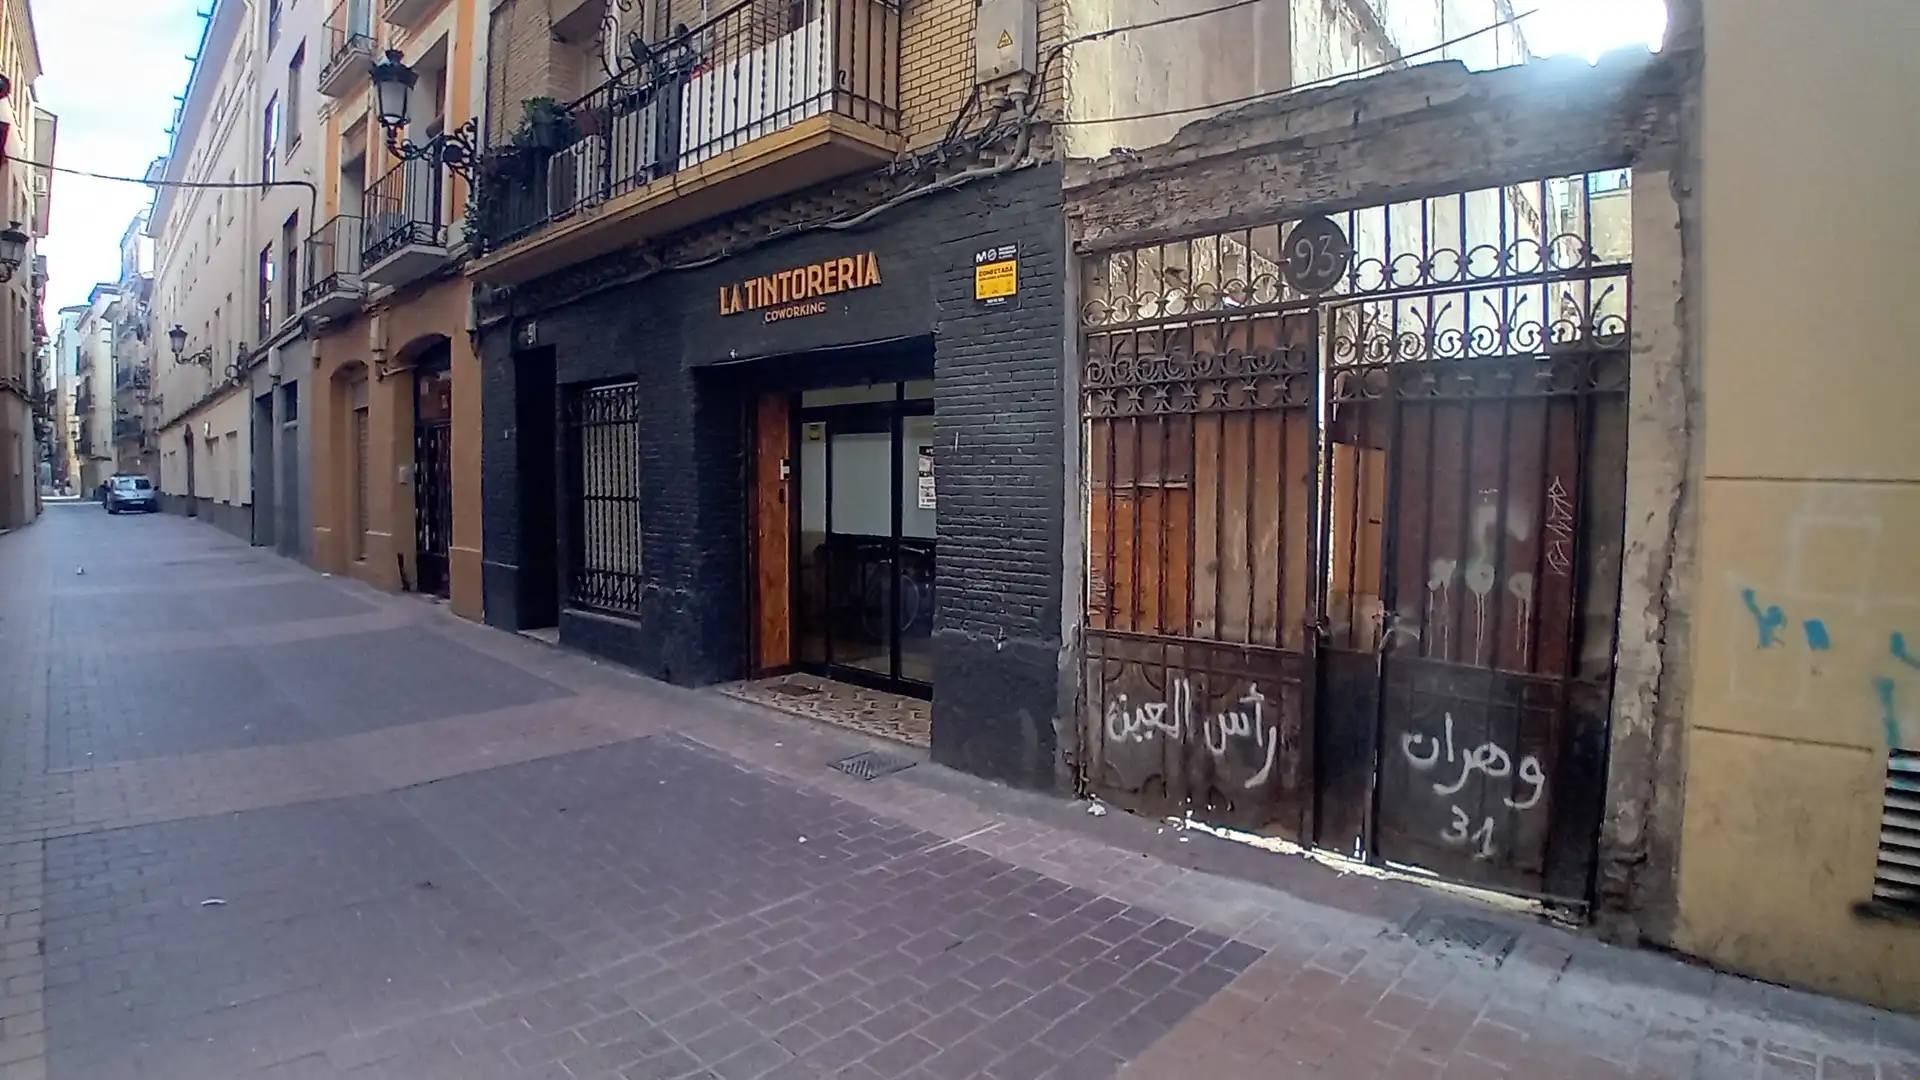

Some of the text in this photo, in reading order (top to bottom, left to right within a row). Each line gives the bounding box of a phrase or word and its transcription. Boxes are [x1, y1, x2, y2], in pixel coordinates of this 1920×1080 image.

[719, 251, 881, 315] LA TINTORERIA
[978, 265, 1014, 277] CONECTADA
[1295, 234, 1336, 279] 93
[764, 301, 827, 323] COWORKING
[1107, 678, 1192, 742] العين
[1402, 711, 1546, 809] وهران
[1440, 804, 1495, 859] 31
